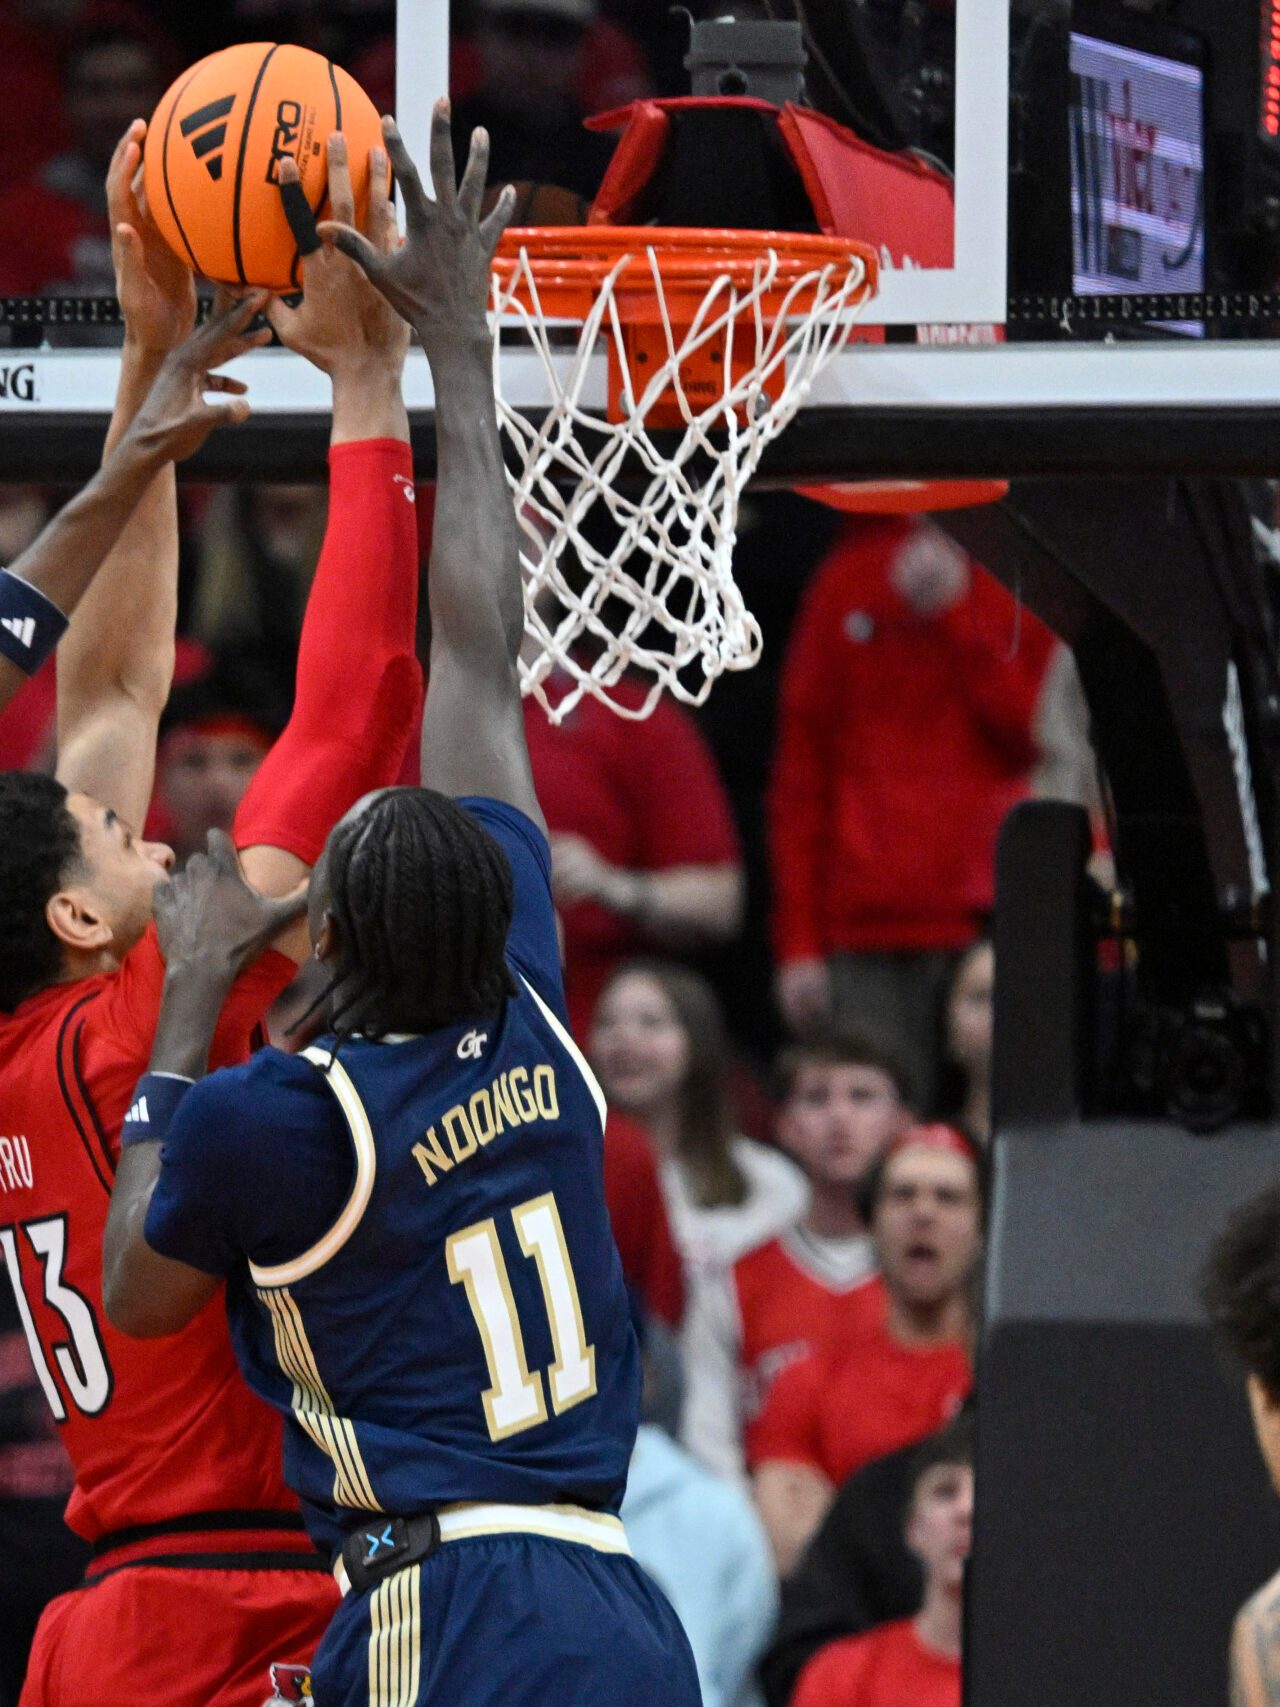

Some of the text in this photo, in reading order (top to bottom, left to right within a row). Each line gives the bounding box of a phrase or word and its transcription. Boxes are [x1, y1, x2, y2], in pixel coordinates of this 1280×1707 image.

[456, 1029, 488, 1060] GT
[411, 1064, 560, 1187] NDONGO
[445, 1190, 598, 1443] 11
